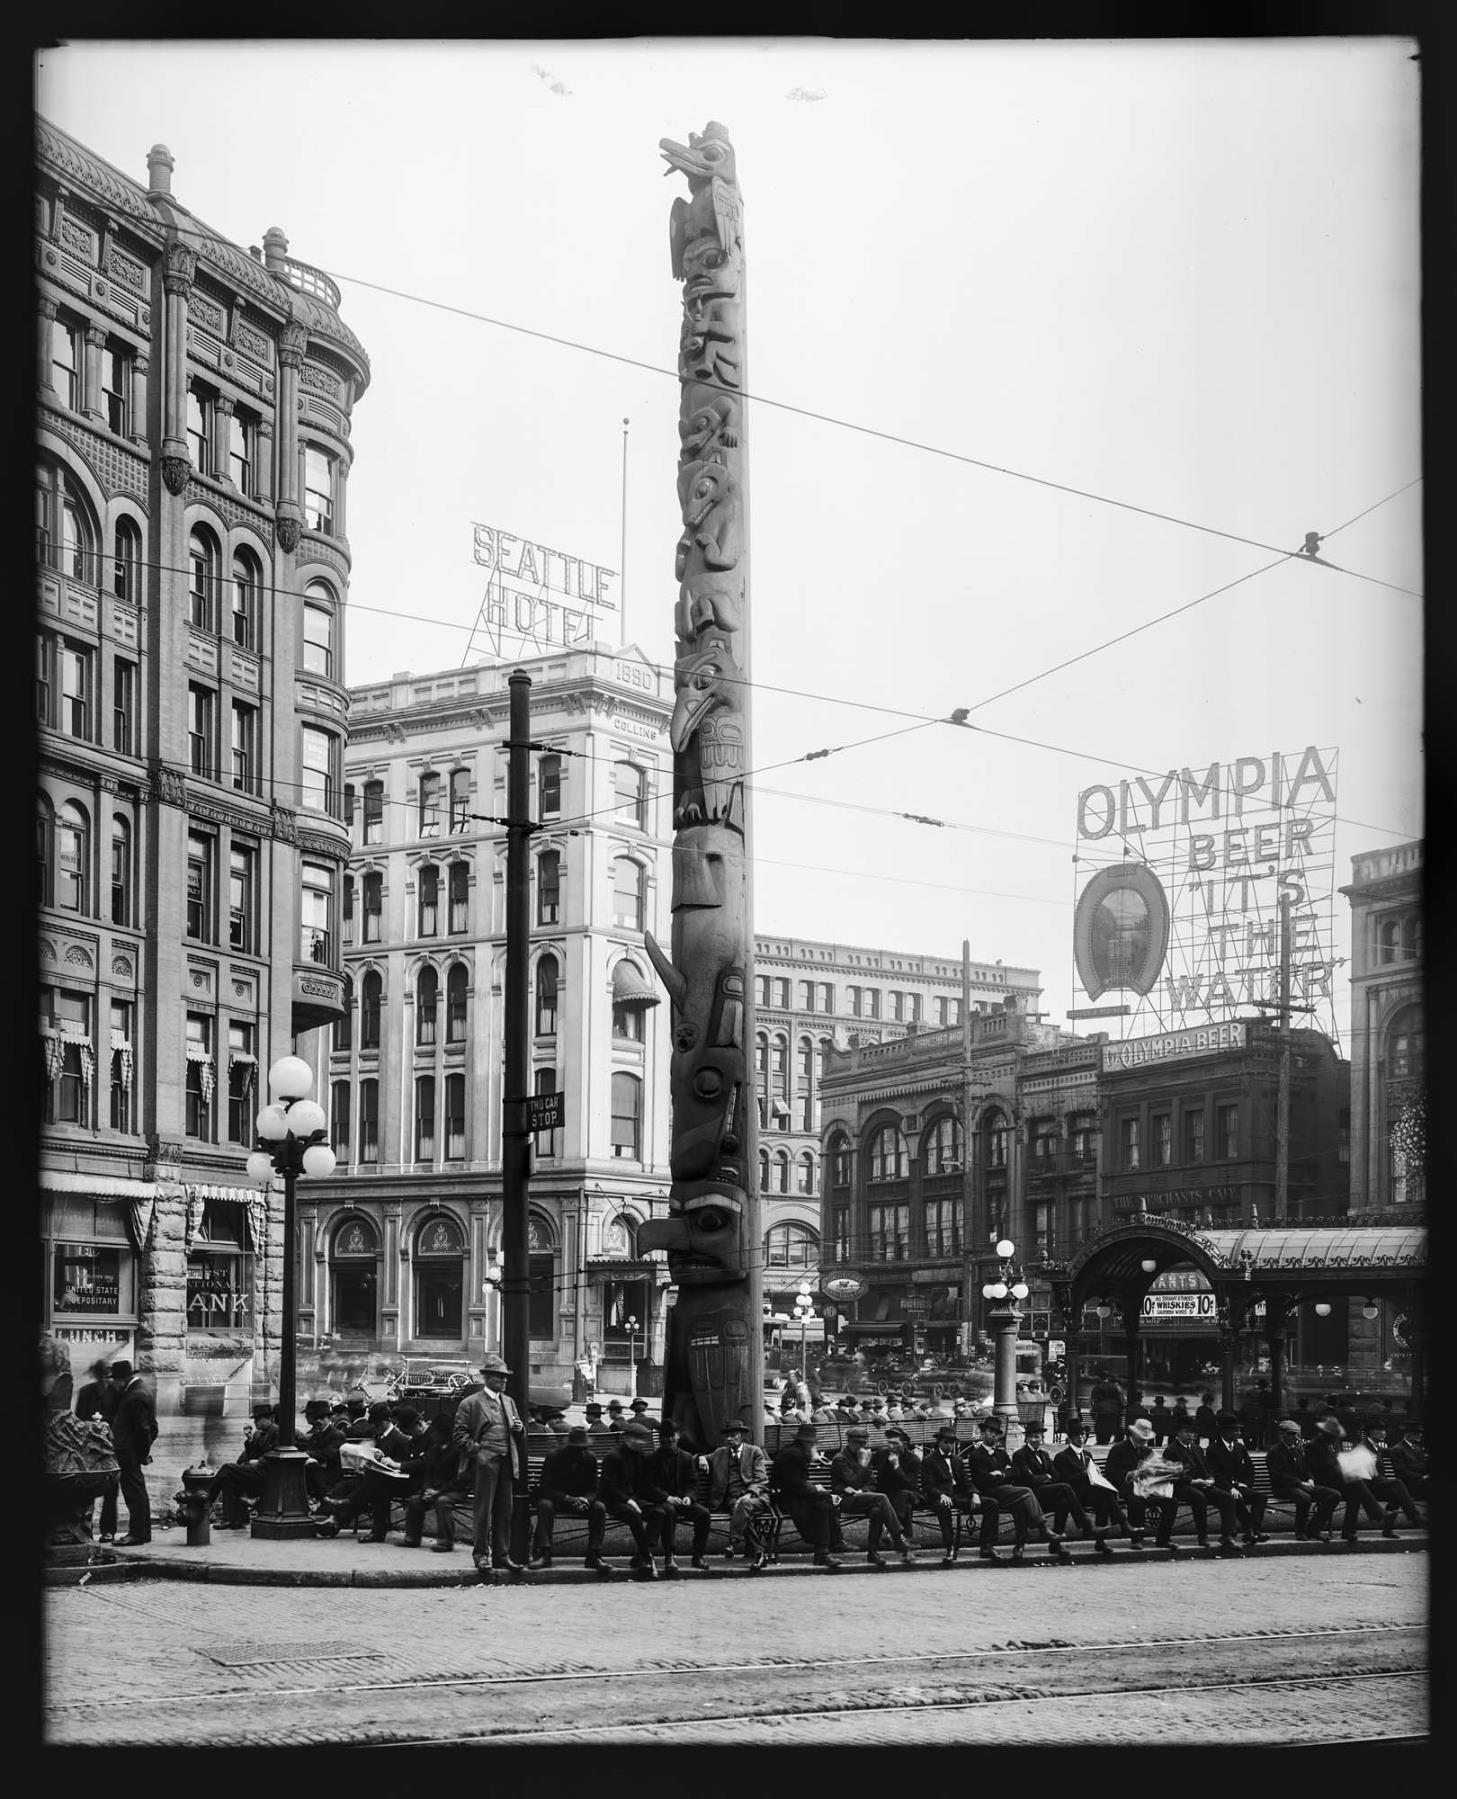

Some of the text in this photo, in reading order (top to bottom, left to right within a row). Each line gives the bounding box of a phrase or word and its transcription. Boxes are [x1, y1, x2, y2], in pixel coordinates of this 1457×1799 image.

[473, 524, 616, 610] SEATTLE
[616, 662, 651, 690] 1890
[614, 719, 657, 741] COLLINS
[1077, 745, 1336, 841] OLYMPIA
[1188, 817, 1314, 873] BEER
[1207, 913, 1319, 962] THE
[1120, 1022, 1242, 1068] OLYMPIA BEER
[545, 1096, 559, 1109] CAR
[531, 1110, 558, 1128] STOP
[65, 1285, 93, 1294] UNITED
[71, 1296, 117, 1305] DEPOSITARY
[187, 1293, 249, 1312] ANK
[1157, 1301, 1196, 1310] WHISKIES
[58, 1330, 116, 1344] LUNCH
